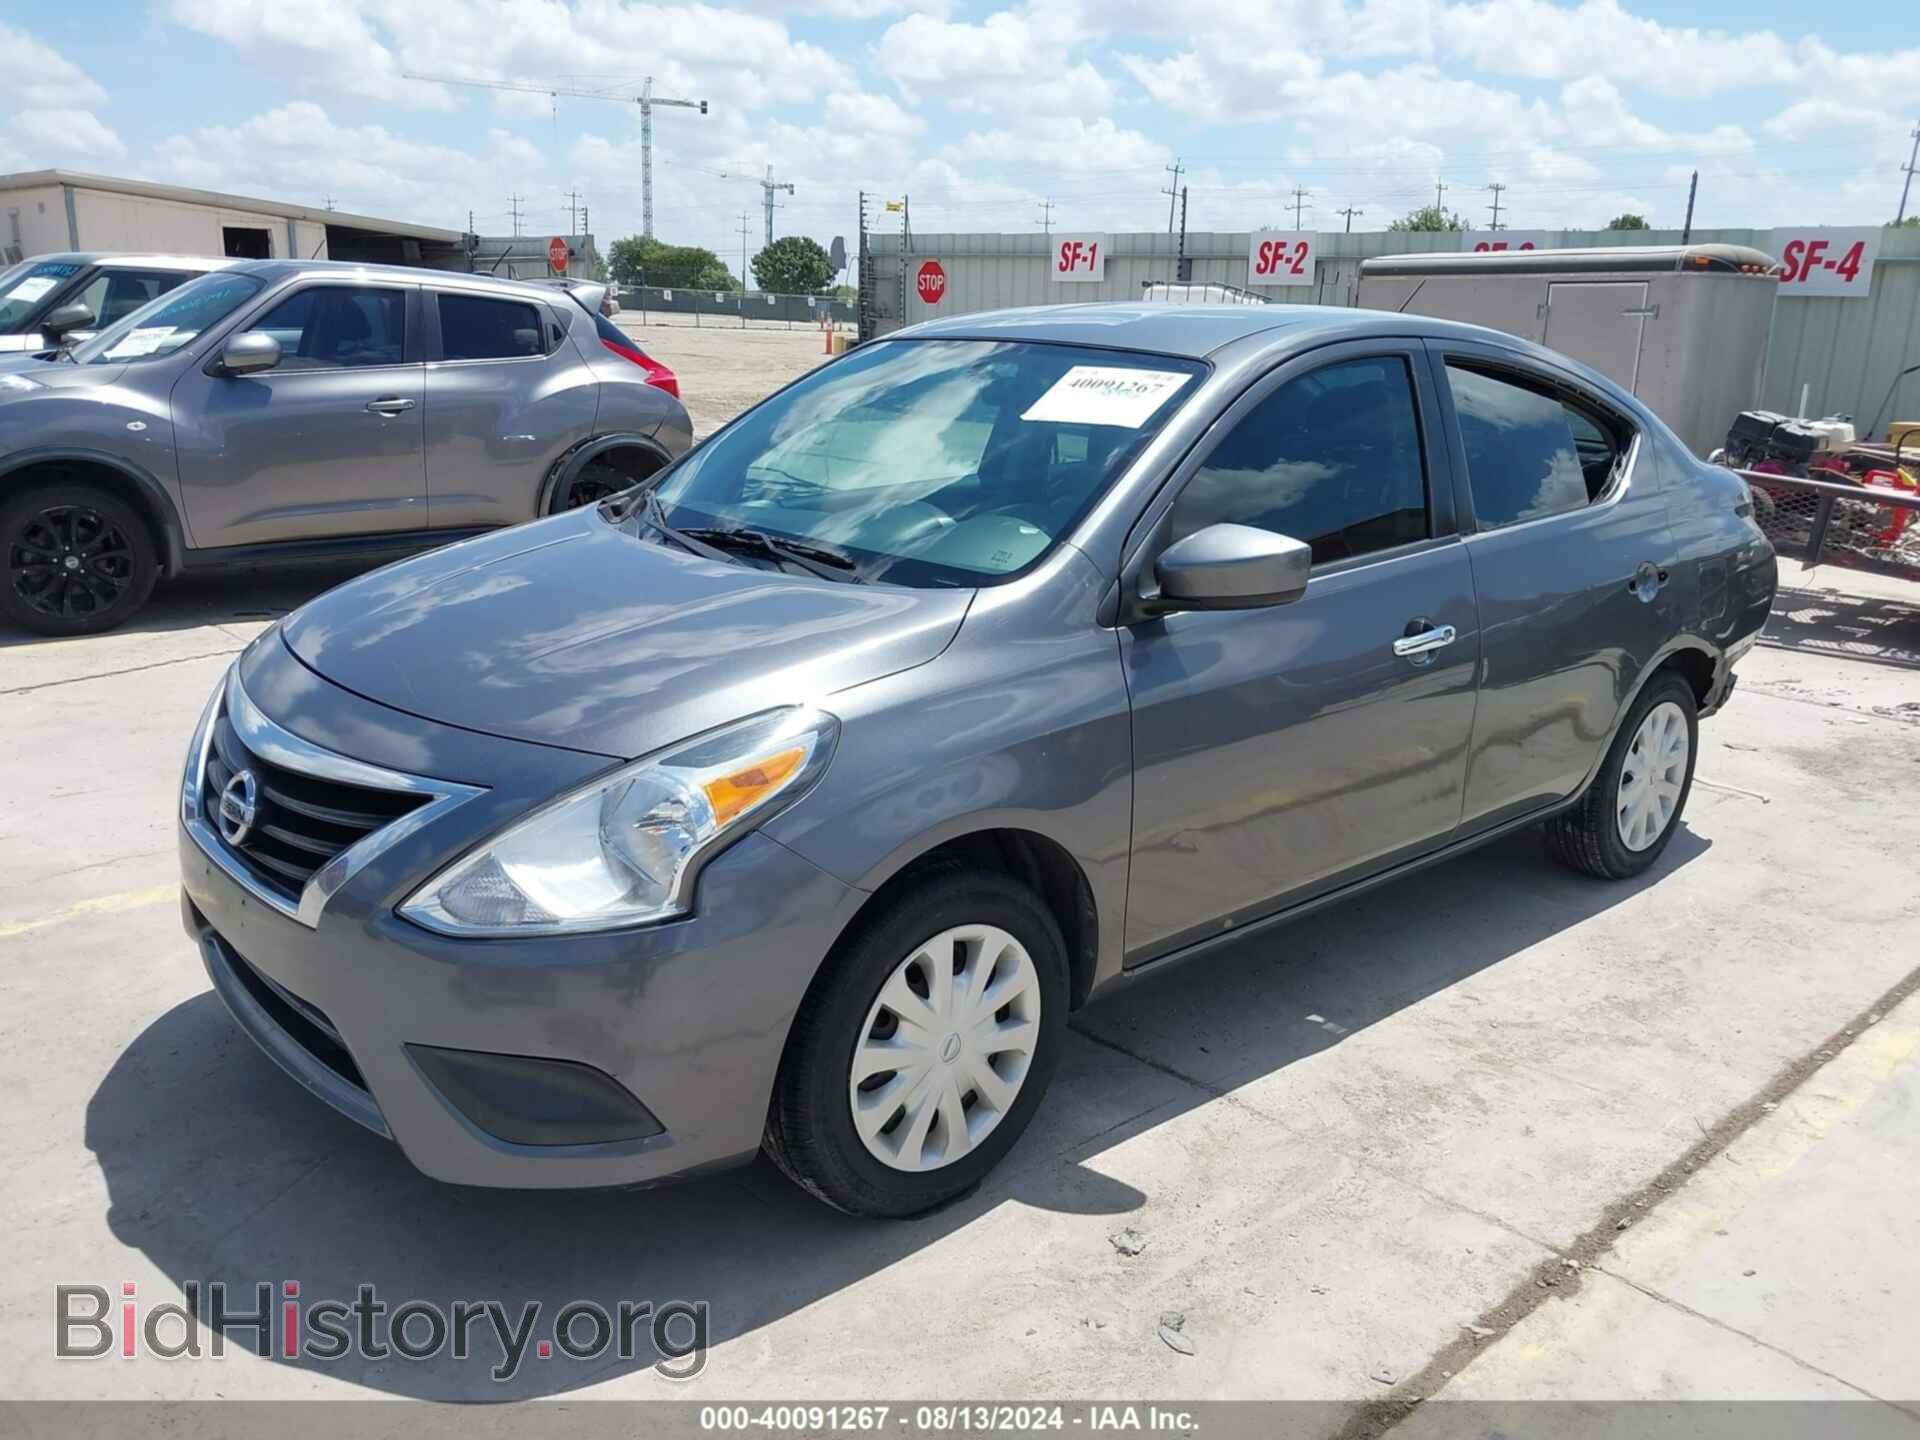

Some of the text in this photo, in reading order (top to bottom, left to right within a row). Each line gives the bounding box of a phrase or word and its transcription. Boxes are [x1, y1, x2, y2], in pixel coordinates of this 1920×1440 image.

[1058, 241, 1097, 272] SF-1
[1256, 241, 1308, 274] SF-2
[1779, 240, 1865, 282] SF-4
[919, 274, 944, 290] STOP
